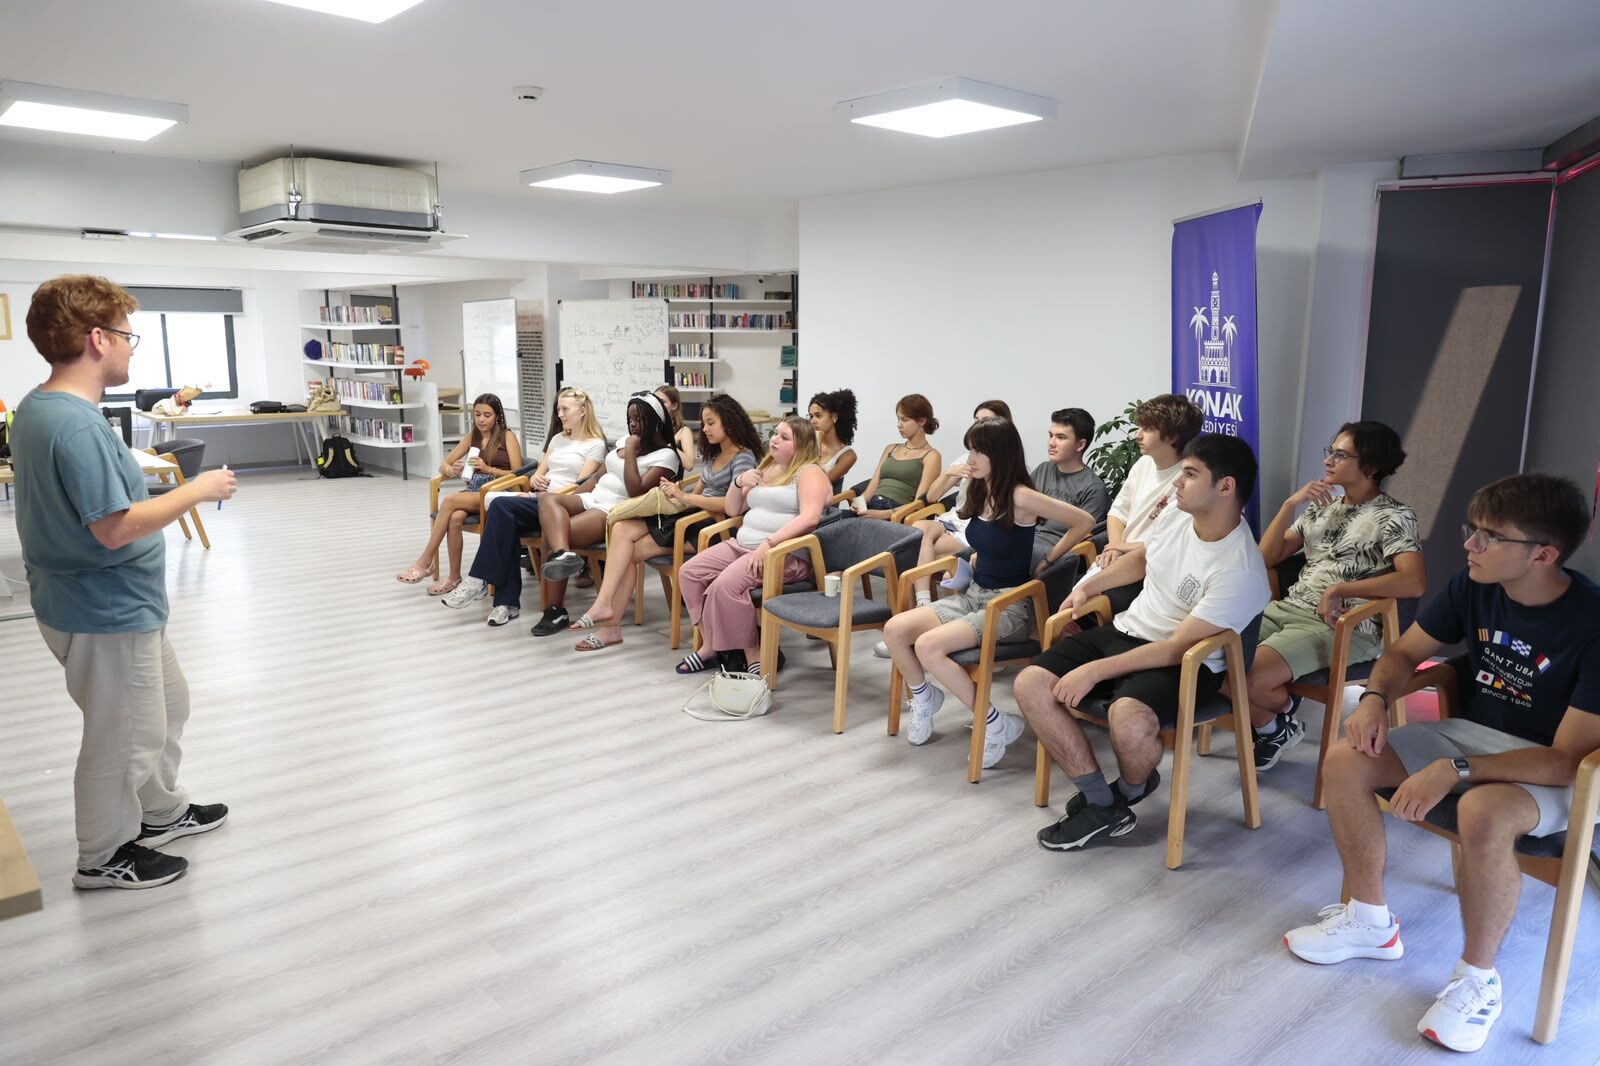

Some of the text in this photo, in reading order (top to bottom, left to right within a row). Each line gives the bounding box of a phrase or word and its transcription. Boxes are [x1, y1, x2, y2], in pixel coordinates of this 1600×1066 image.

[1201, 418, 1238, 437] LEDİYESİ
[1484, 647, 1513, 667] GANT
[1515, 663, 1534, 678] USA
[1481, 687, 1508, 701] SINCE
